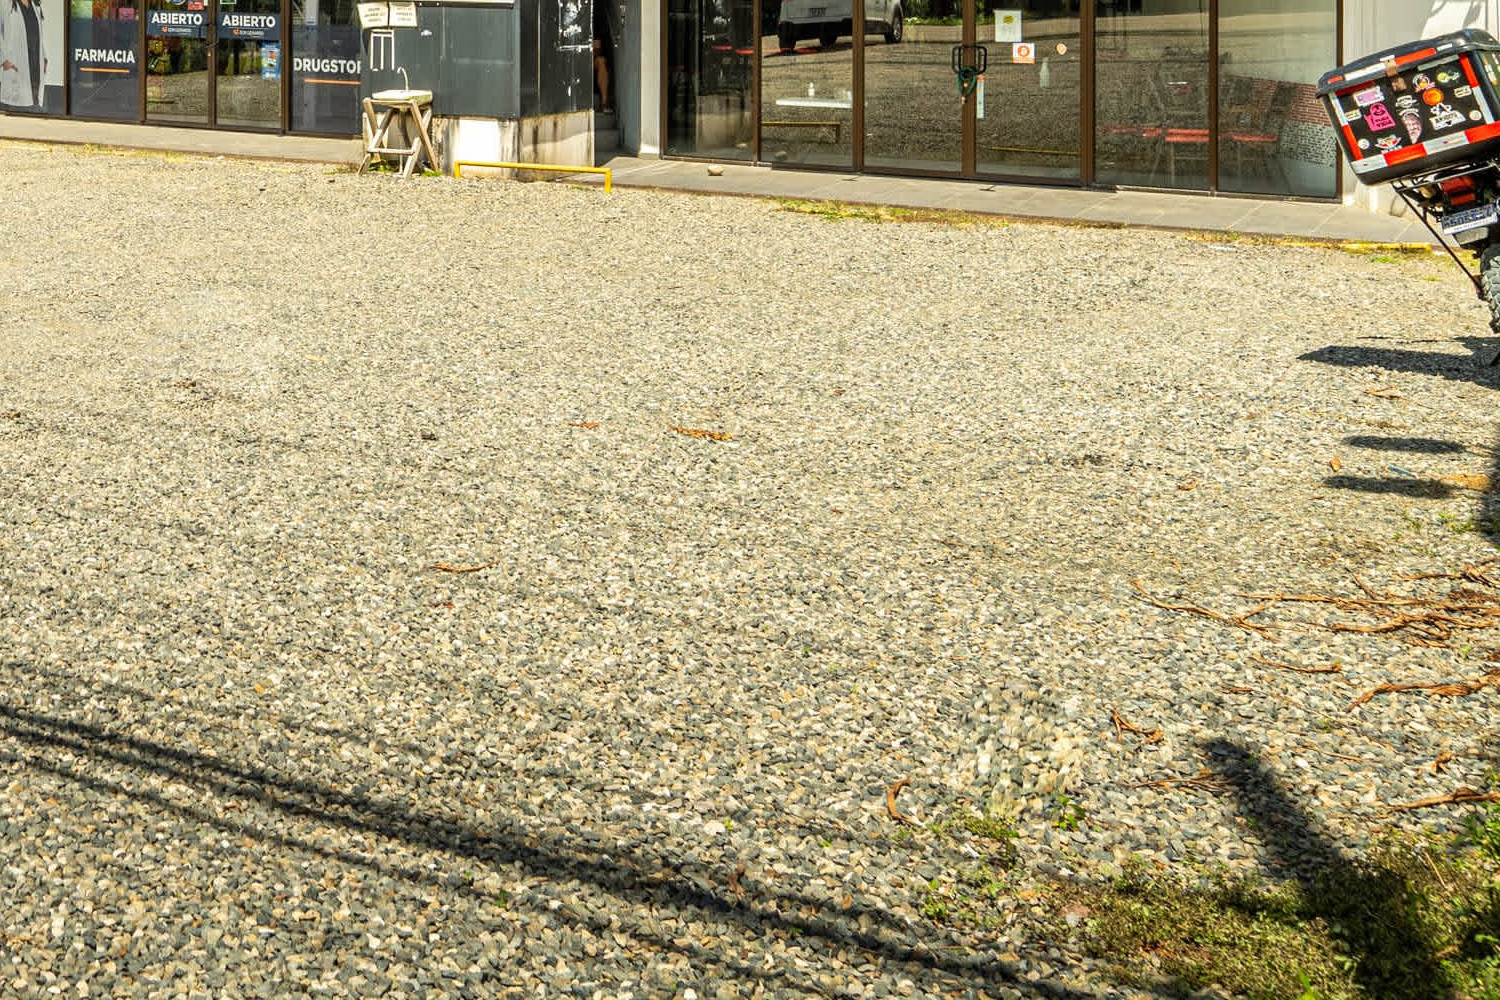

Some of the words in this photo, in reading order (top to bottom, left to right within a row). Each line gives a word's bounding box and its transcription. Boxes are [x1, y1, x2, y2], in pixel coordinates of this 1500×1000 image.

[151, 12, 203, 25] ABIERTO
[222, 15, 276, 28] ABIERTO
[75, 48, 135, 64] FARMACIA
